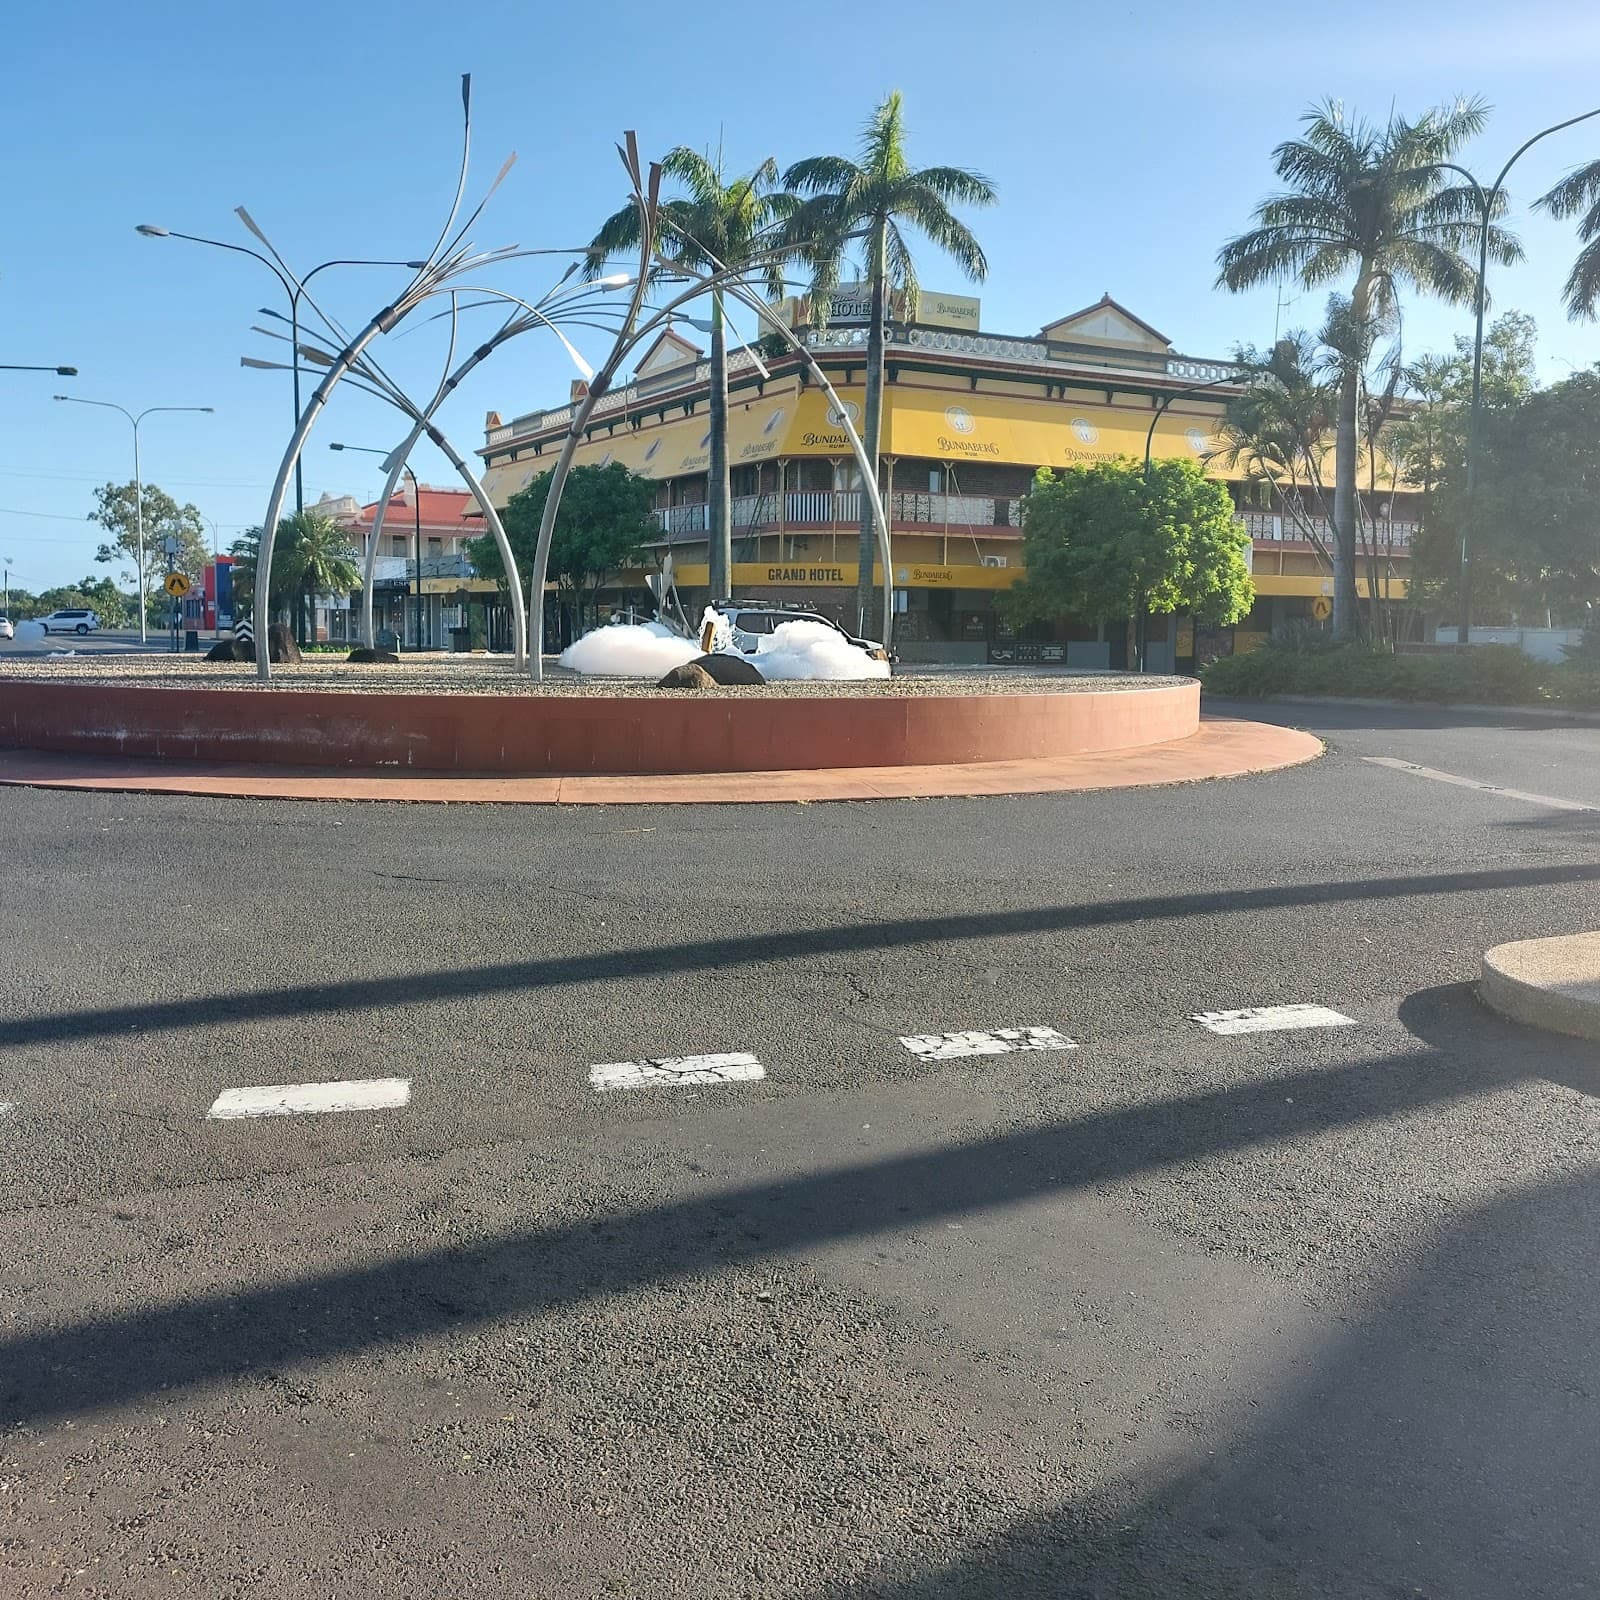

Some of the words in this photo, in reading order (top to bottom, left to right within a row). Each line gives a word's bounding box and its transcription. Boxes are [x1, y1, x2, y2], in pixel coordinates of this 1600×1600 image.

[831, 302, 872, 317] HOTE
[937, 436, 1000, 455] BUNDABERG
[768, 568, 806, 581] GRAND
[809, 568, 844, 581] HOTEL
